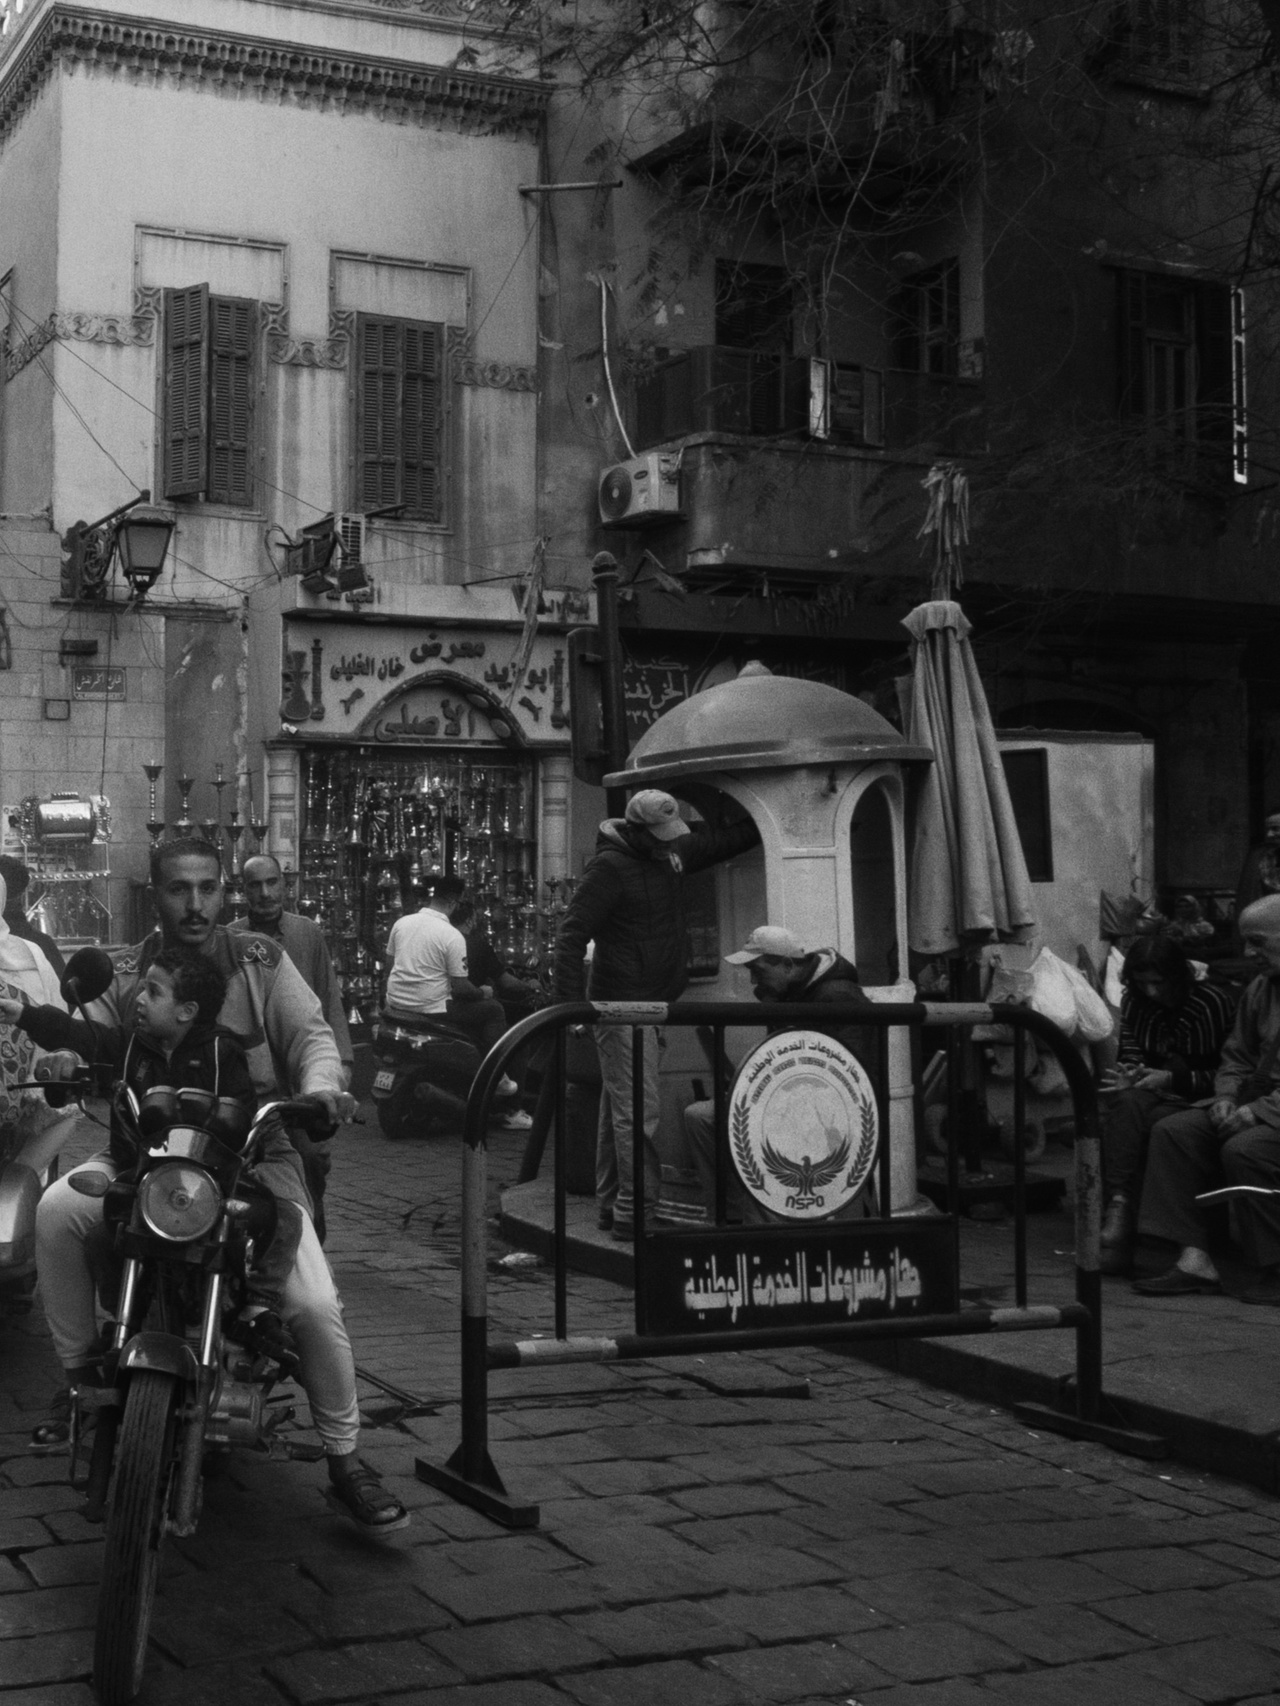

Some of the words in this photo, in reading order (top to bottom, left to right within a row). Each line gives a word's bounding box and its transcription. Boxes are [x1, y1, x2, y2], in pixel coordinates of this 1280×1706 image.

[378, 656, 404, 680] خان
[410, 633, 485, 663] معرض
[785, 1195, 824, 1210] NSPO
[684, 1253, 747, 1323] الوطنية
[752, 1251, 807, 1307] الخدمة
[809, 1249, 886, 1316] مشروعات
[887, 1247, 920, 1310] جهاز
